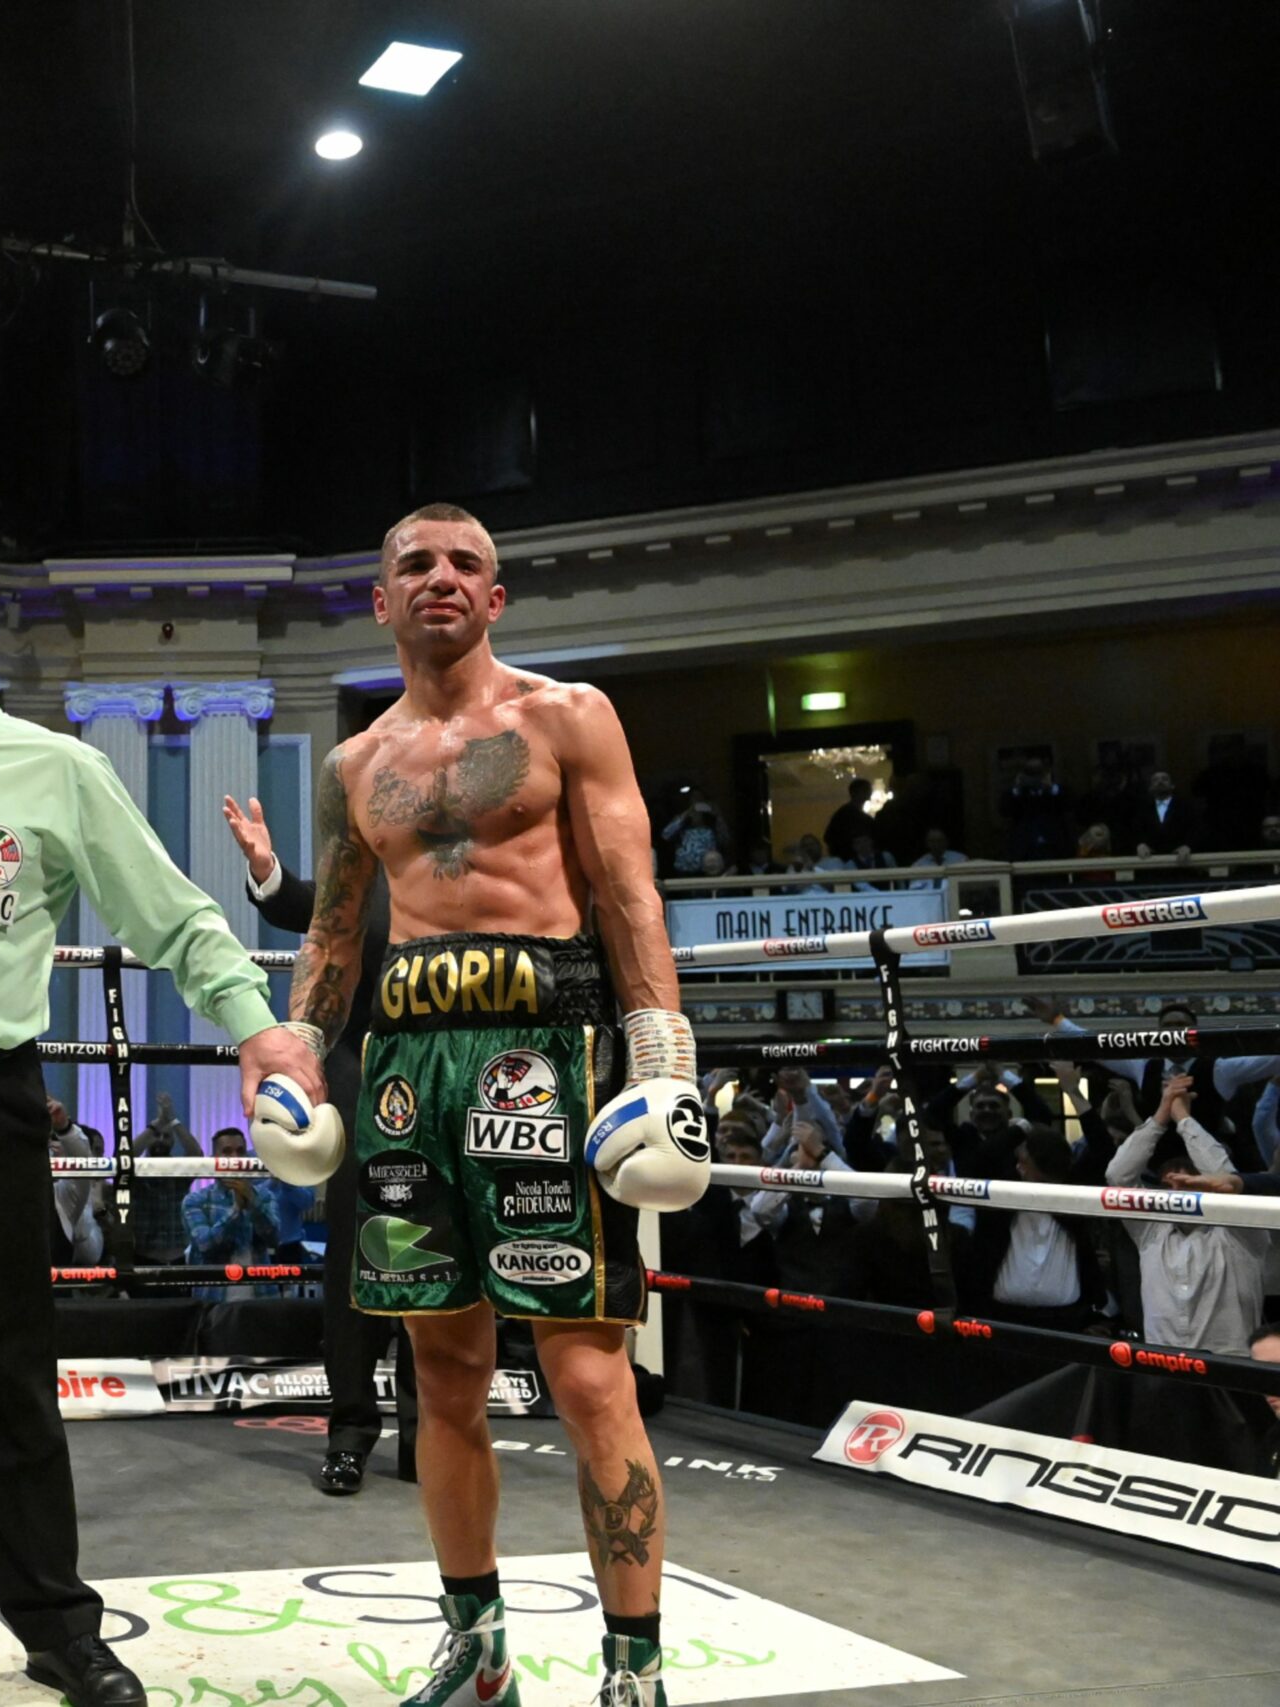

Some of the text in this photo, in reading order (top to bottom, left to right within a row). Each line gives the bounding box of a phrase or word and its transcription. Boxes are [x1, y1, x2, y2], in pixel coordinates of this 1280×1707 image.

[716, 905, 894, 939] MAIN ENTRANCE
[1106, 901, 1200, 926] BETFRED
[917, 924, 990, 945] BETFRED
[53, 948, 105, 960] ETFRE
[766, 937, 823, 955] BETFRED
[381, 948, 538, 1019] GLORIA
[472, 1117, 563, 1154] WBC
[516, 1180, 571, 1195] Nicola Tonelli
[764, 1170, 821, 1186] BETFRED
[517, 1196, 571, 1214] FIDEURAM
[1105, 1189, 1197, 1213] BETFRED
[497, 1253, 581, 1271] KANGOO
[61, 1266, 117, 1282] empire
[247, 1265, 301, 1281] empire
[1136, 1350, 1207, 1374] empire
[174, 1372, 269, 1395] TIVAC
[664, 1456, 784, 1476] INK
